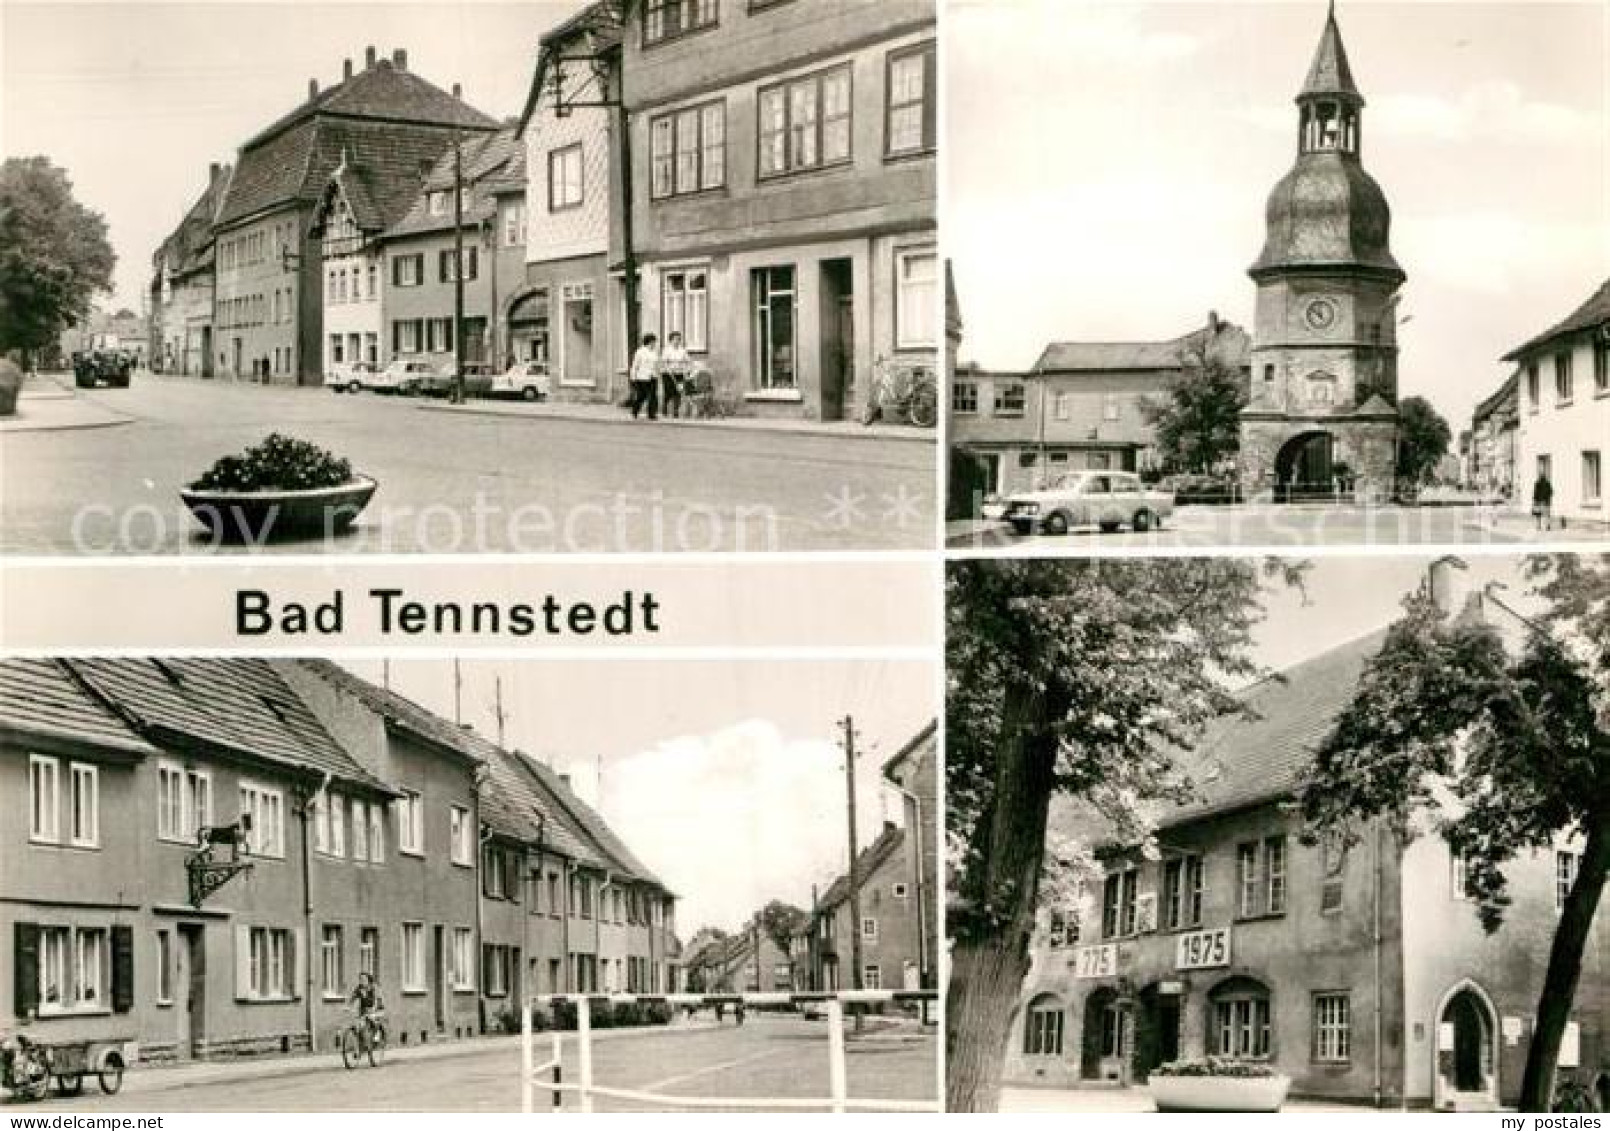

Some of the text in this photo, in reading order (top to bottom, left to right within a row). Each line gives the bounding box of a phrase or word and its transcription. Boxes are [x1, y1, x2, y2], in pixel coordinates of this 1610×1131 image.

[236, 589, 660, 635] Bad Tennstedt
[1082, 947, 1110, 974] 775
[1183, 931, 1224, 964] 1975
